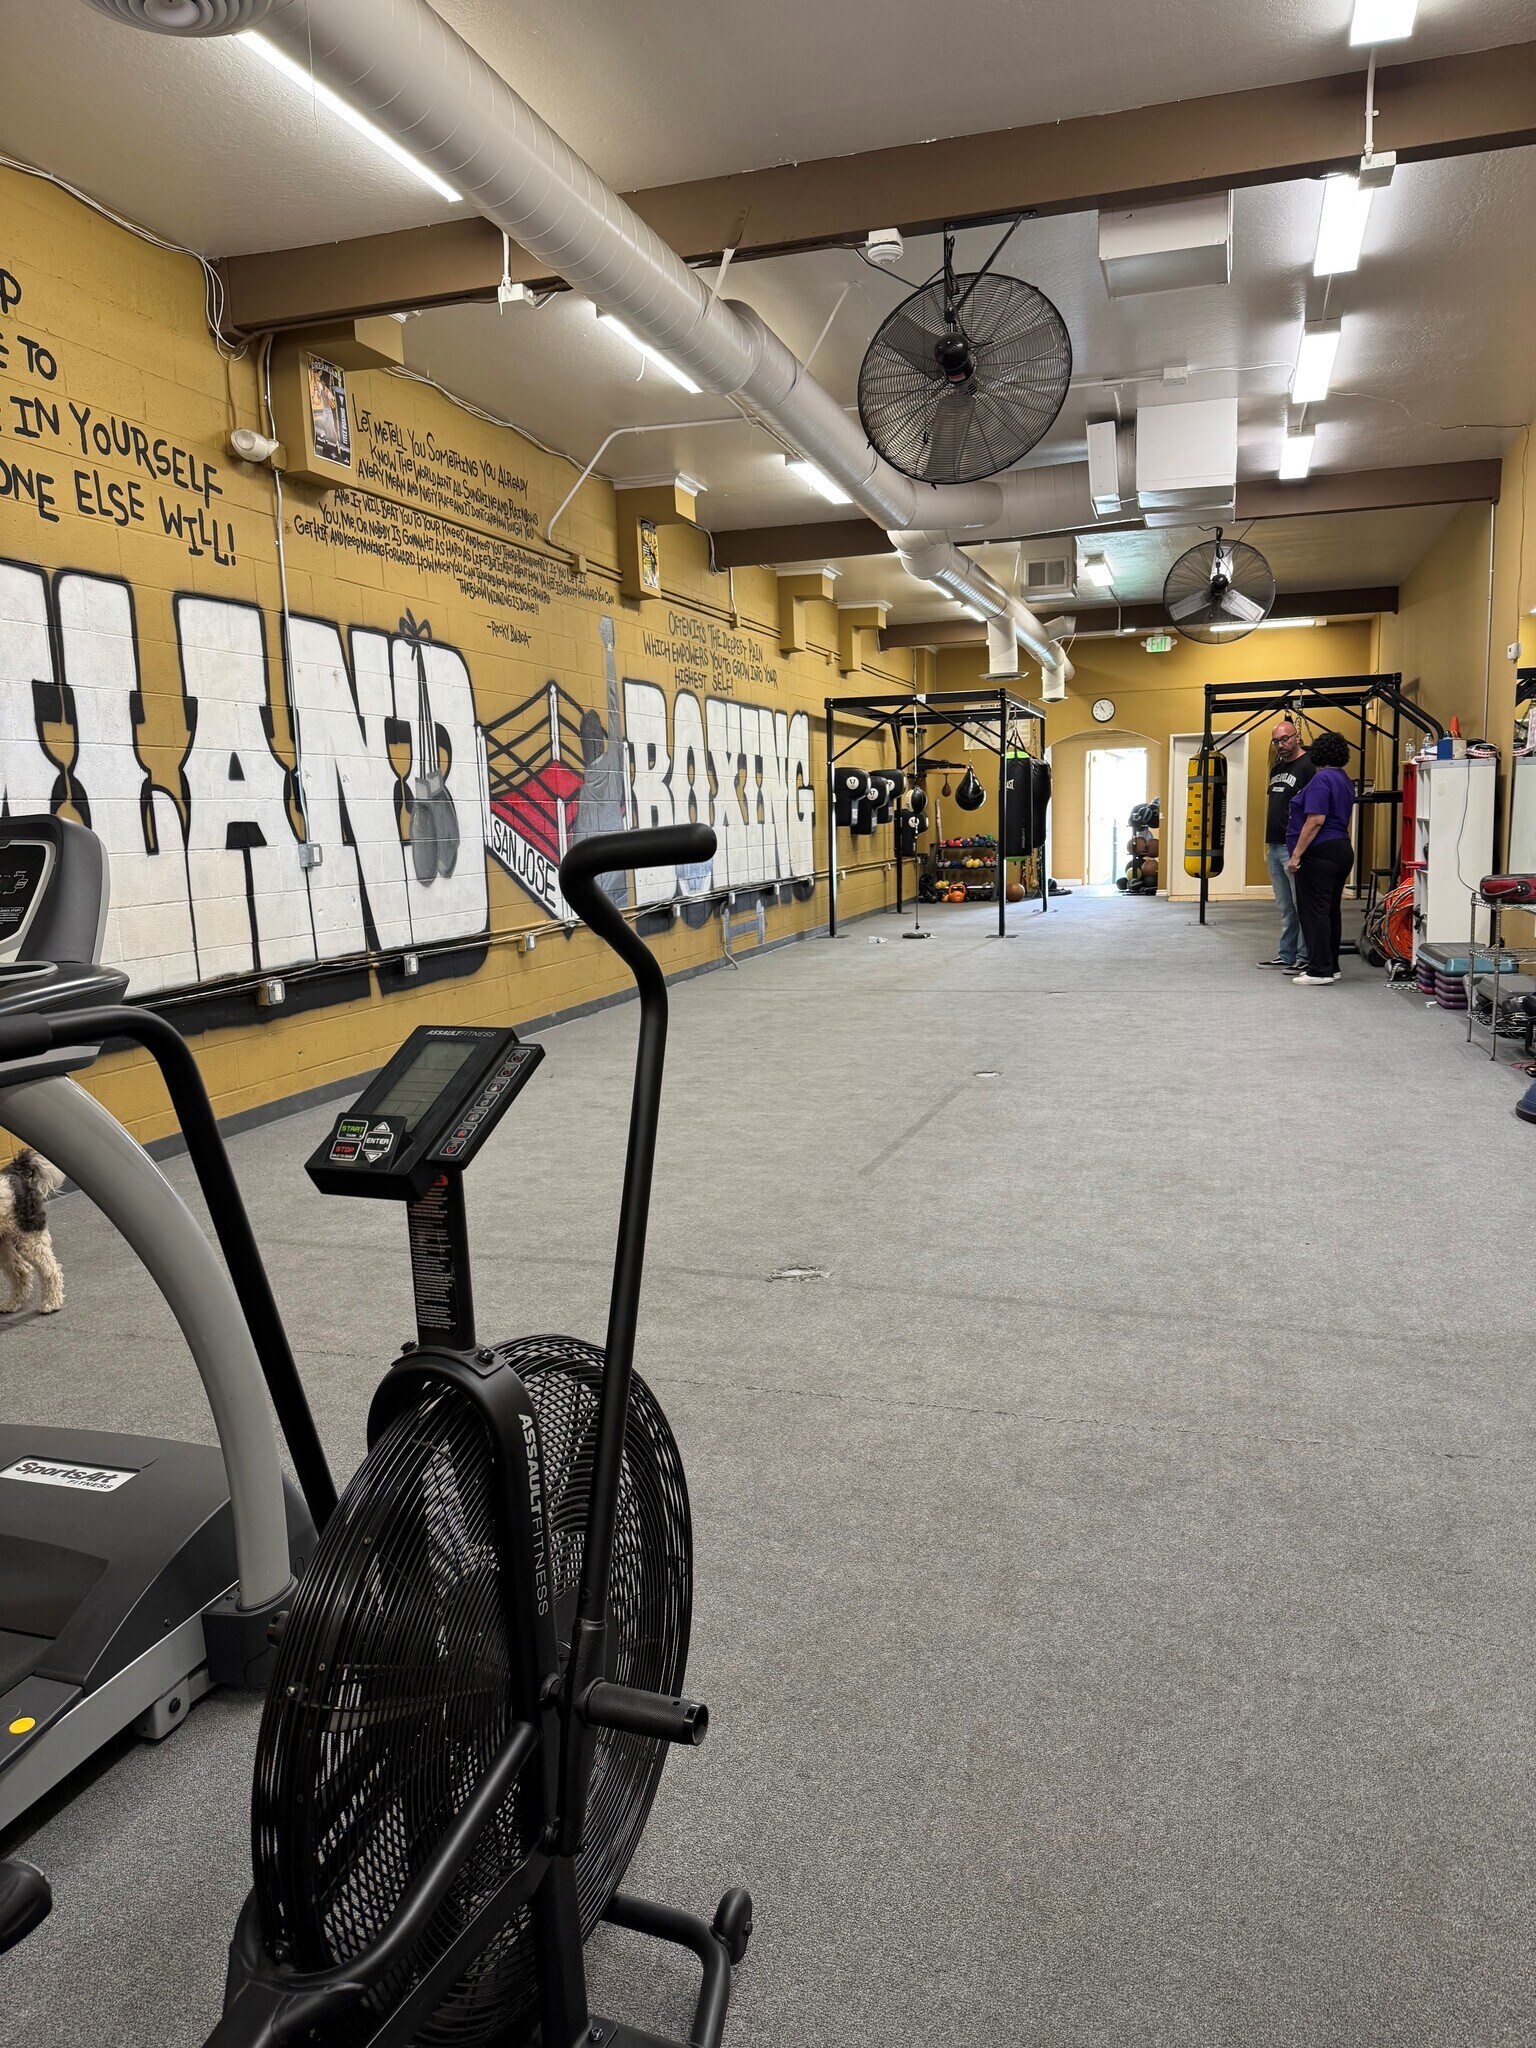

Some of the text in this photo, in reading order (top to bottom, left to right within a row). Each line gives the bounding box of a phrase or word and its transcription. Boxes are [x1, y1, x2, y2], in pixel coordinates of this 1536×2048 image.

[17, 335, 57, 380] TO
[10, 396, 223, 508] IN YOURSELF
[74, 470, 144, 526] ELSE
[159, 496, 237, 566] WILL!
[1150, 637, 1168, 651] EXIT
[622, 677, 816, 907] BOXING
[494, 819, 556, 909] SAN JOSE
[16, 1461, 119, 1484] SportsArt
[67, 1479, 113, 1489] FITNESS
